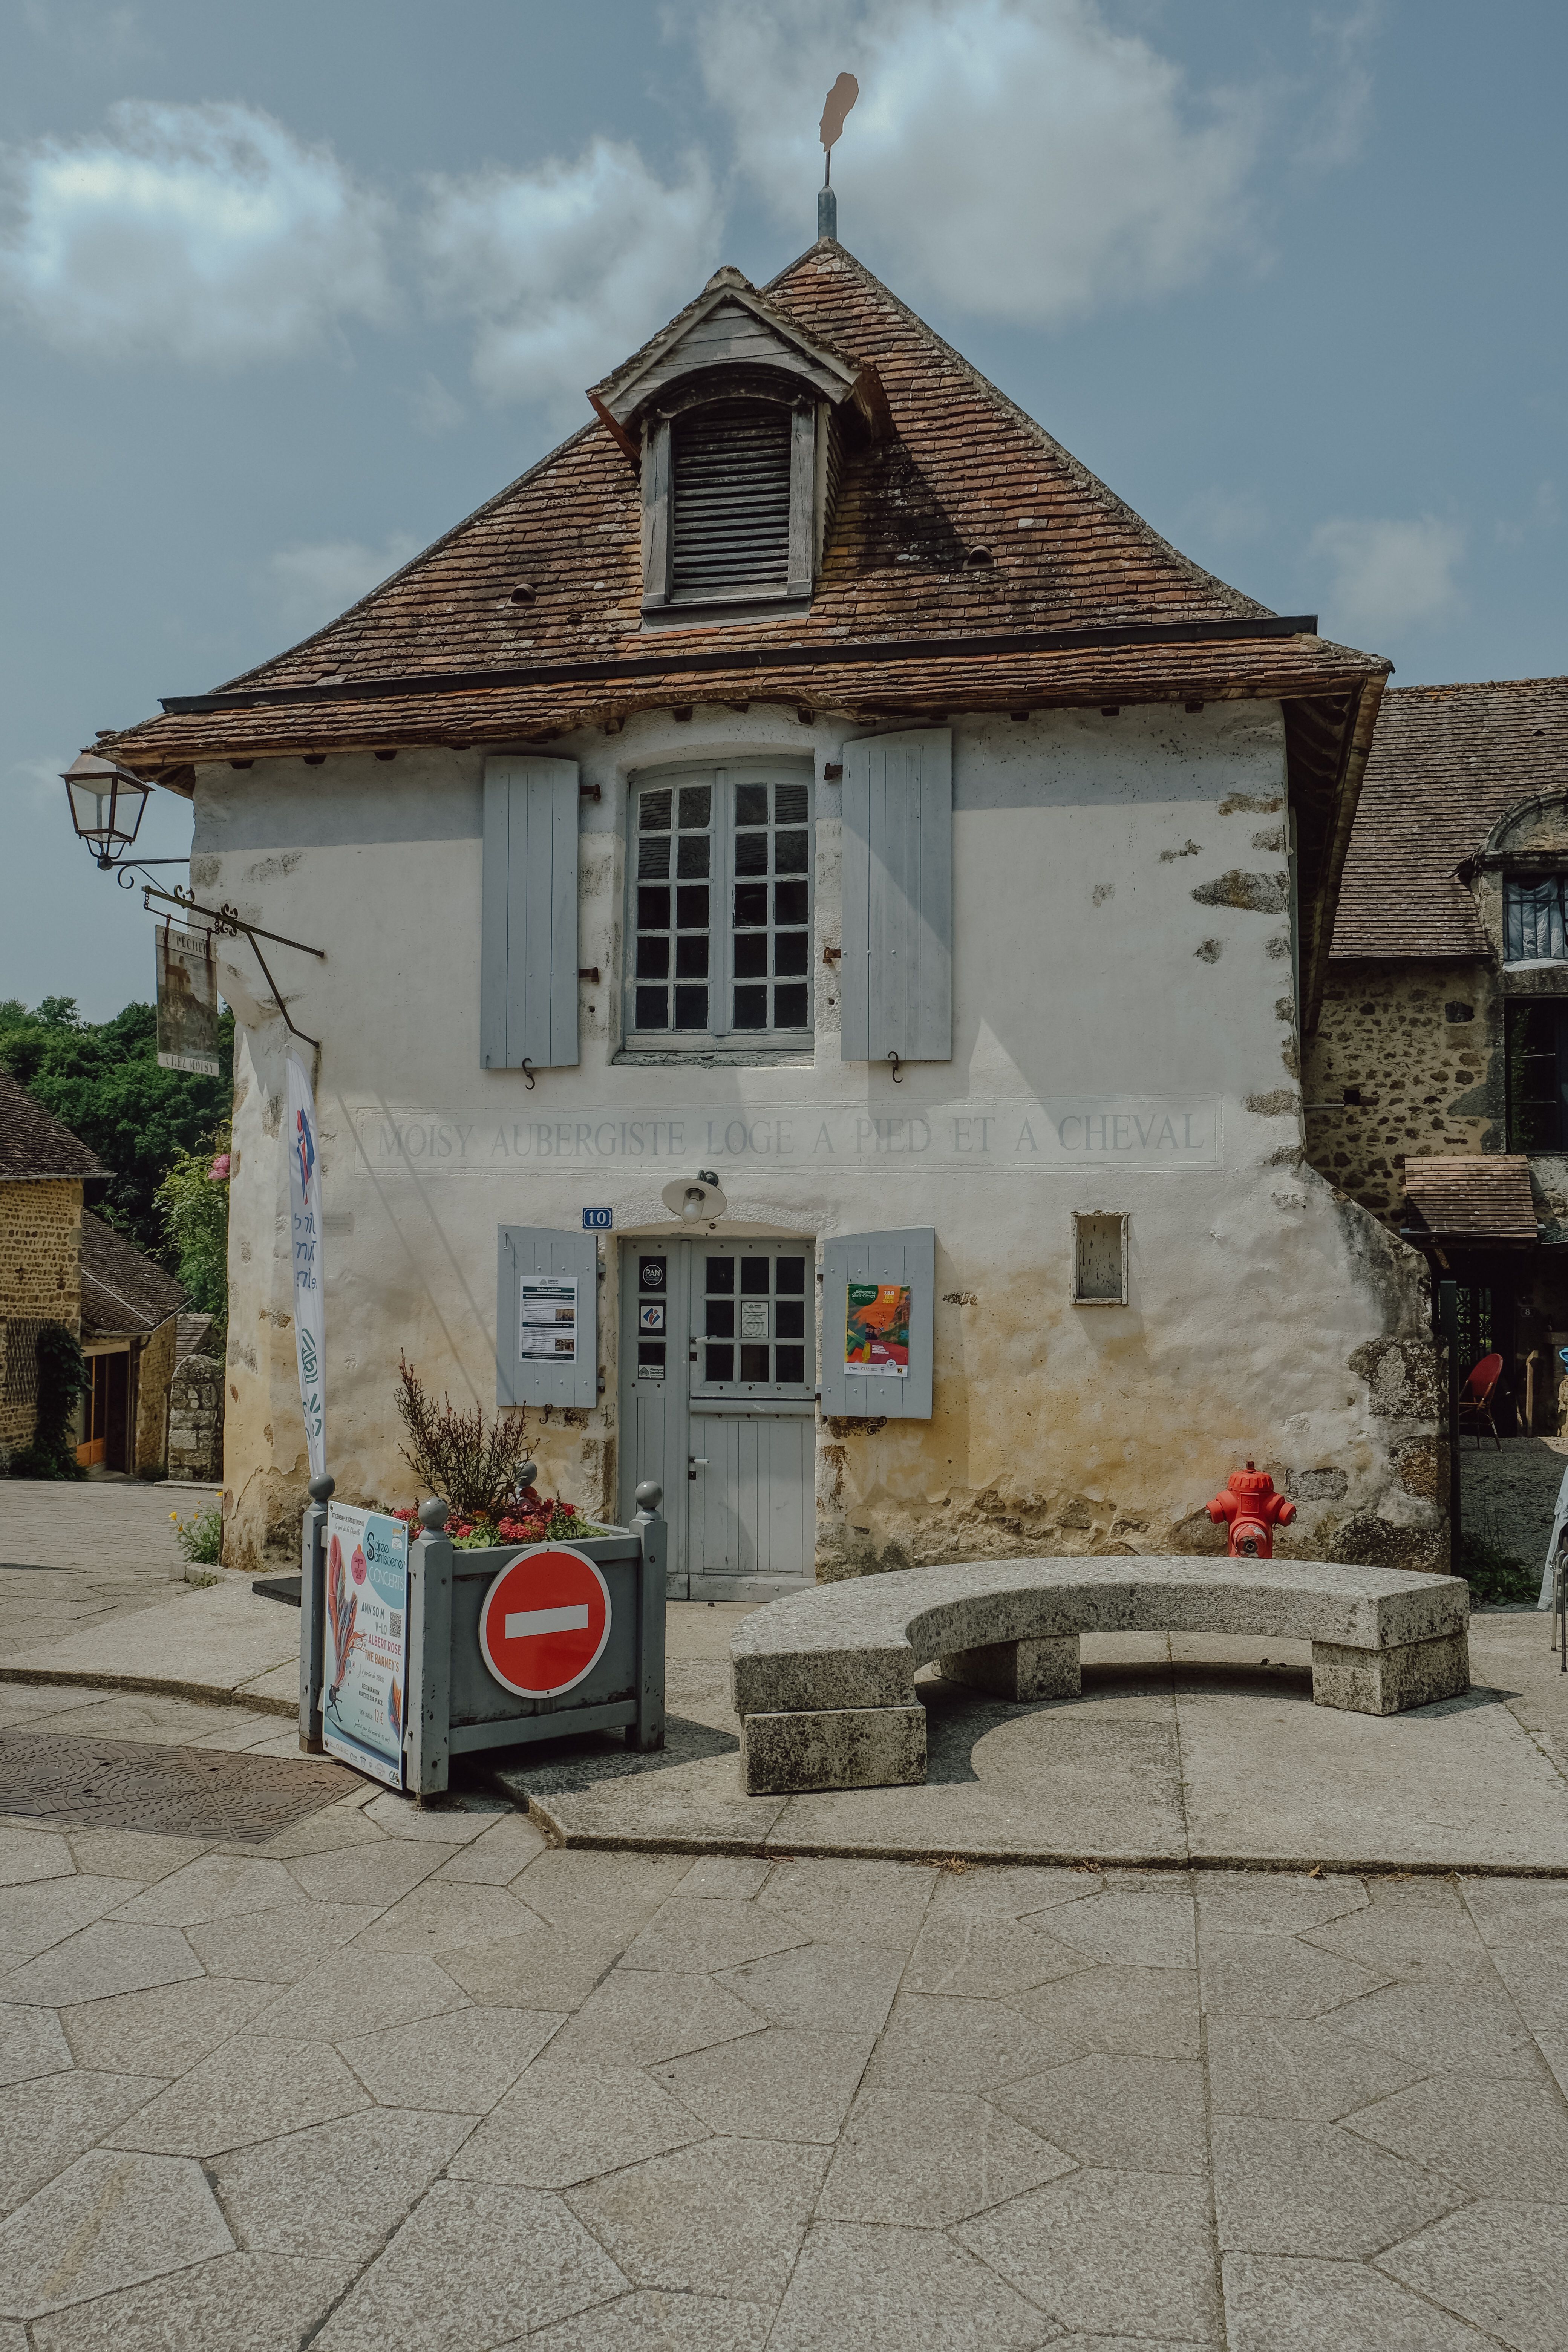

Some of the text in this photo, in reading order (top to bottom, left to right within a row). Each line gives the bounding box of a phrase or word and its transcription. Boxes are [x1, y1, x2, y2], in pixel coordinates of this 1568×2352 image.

[166, 1056, 213, 1073] CHEZ MOISY
[378, 1113, 1205, 1158] MOISY AUBERGISTE LOGE A PIED ET A CHEVAL
[589, 1211, 607, 1225] 10
[369, 1566, 404, 1591] CONCERTS
[361, 1602, 384, 1620] ANN'SO M
[375, 1621, 387, 1635] V-LO
[368, 1634, 401, 1656] ALBERT ROSE
[365, 1649, 399, 1673] THE BARNEY'S
[375, 1697, 384, 1706] PLACE
[374, 1709, 379, 1723] 12
[380, 1712, 384, 1725] €
